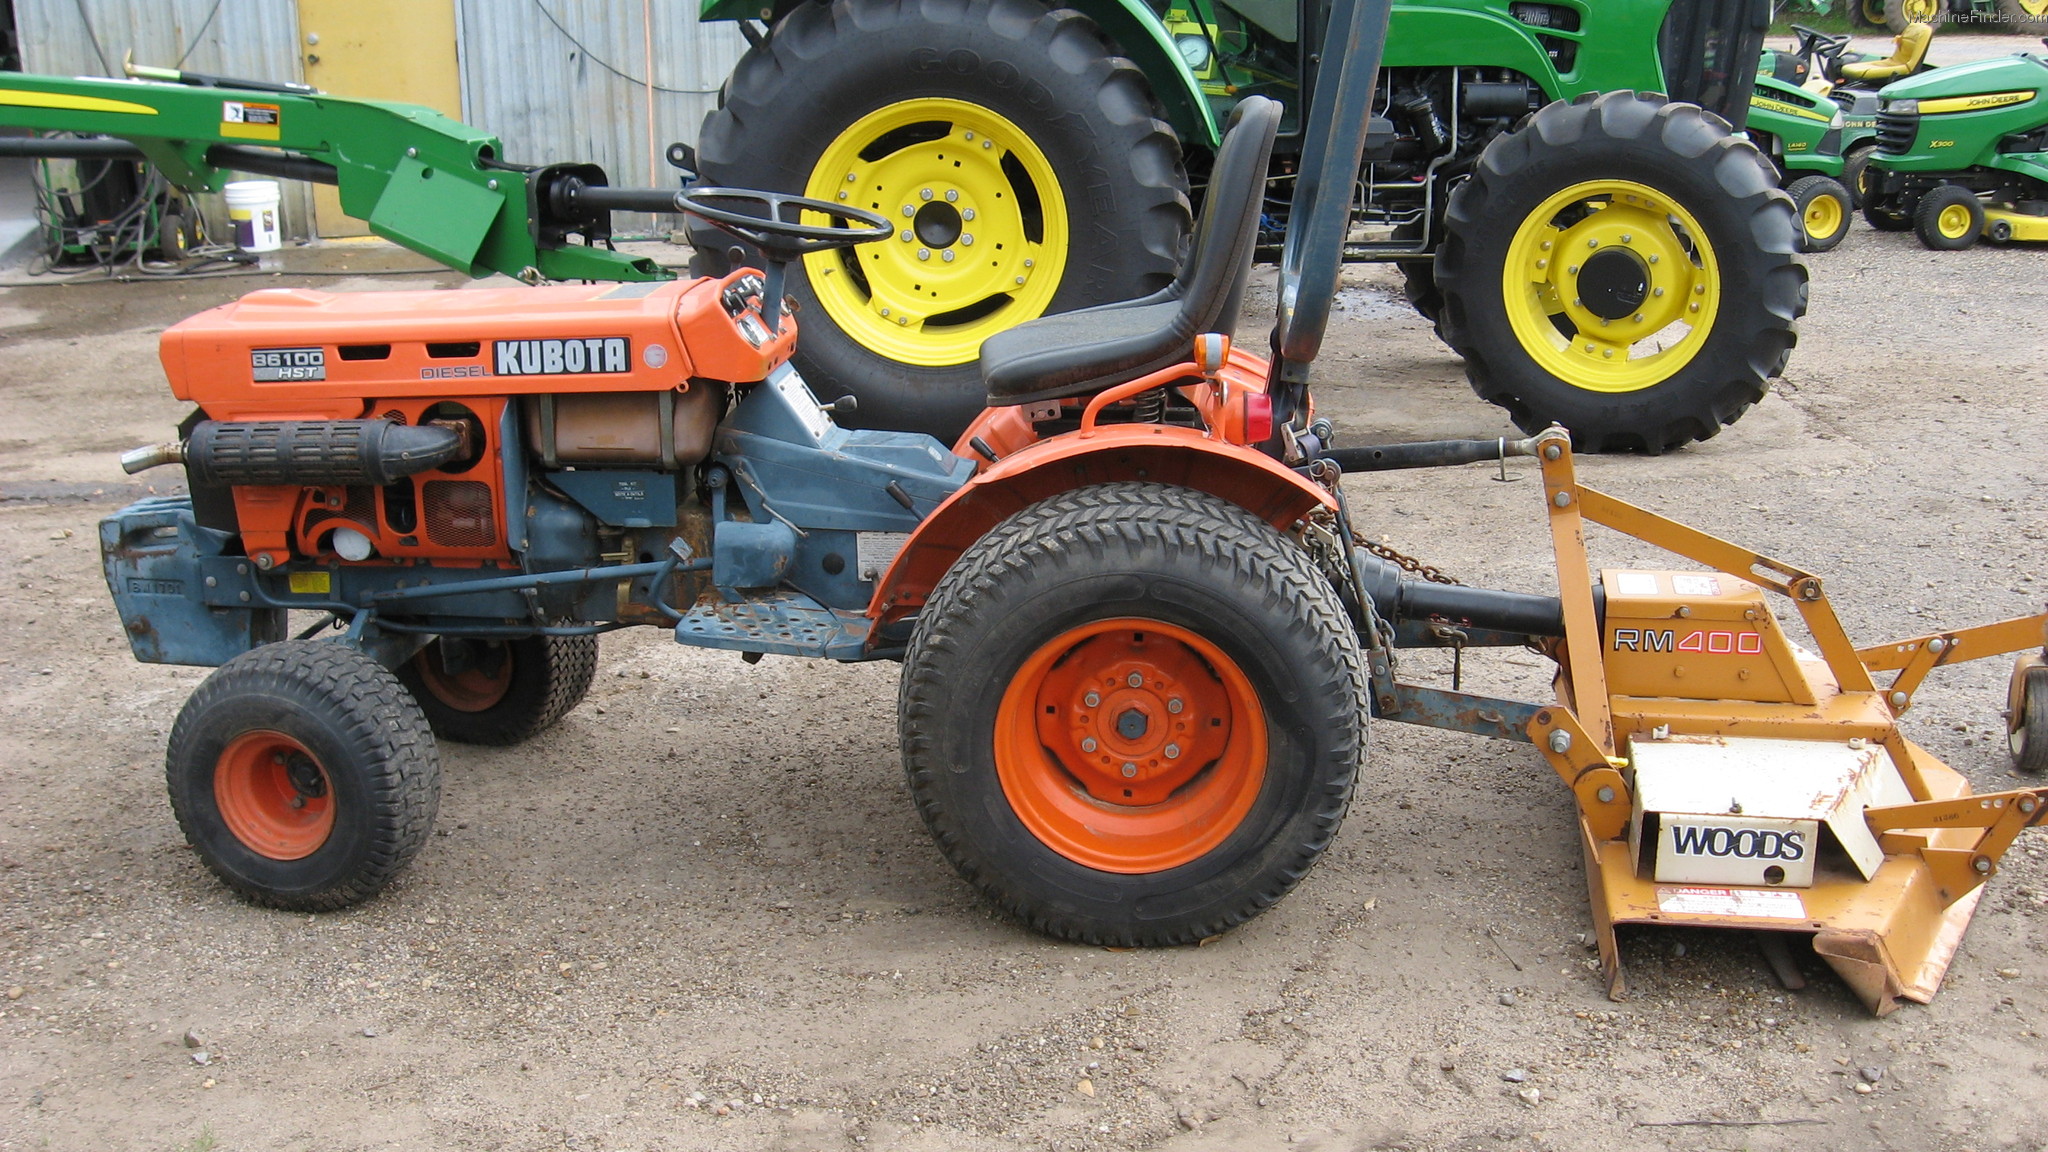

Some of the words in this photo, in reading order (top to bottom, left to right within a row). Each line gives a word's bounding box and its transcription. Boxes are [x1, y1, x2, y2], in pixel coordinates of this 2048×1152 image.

[1755, 100, 1776, 110] JOHN
[1775, 104, 1798, 115] DEERE
[1967, 98, 1990, 107] JOHN
[1991, 95, 2020, 104] DEERE
[253, 352, 323, 367] B6100
[497, 338, 626, 375] KUBOTA
[278, 367, 318, 378] HST
[420, 366, 493, 380] DIESEL
[1671, 825, 1806, 861] WOODS
[1673, 886, 1731, 897] DANGER
